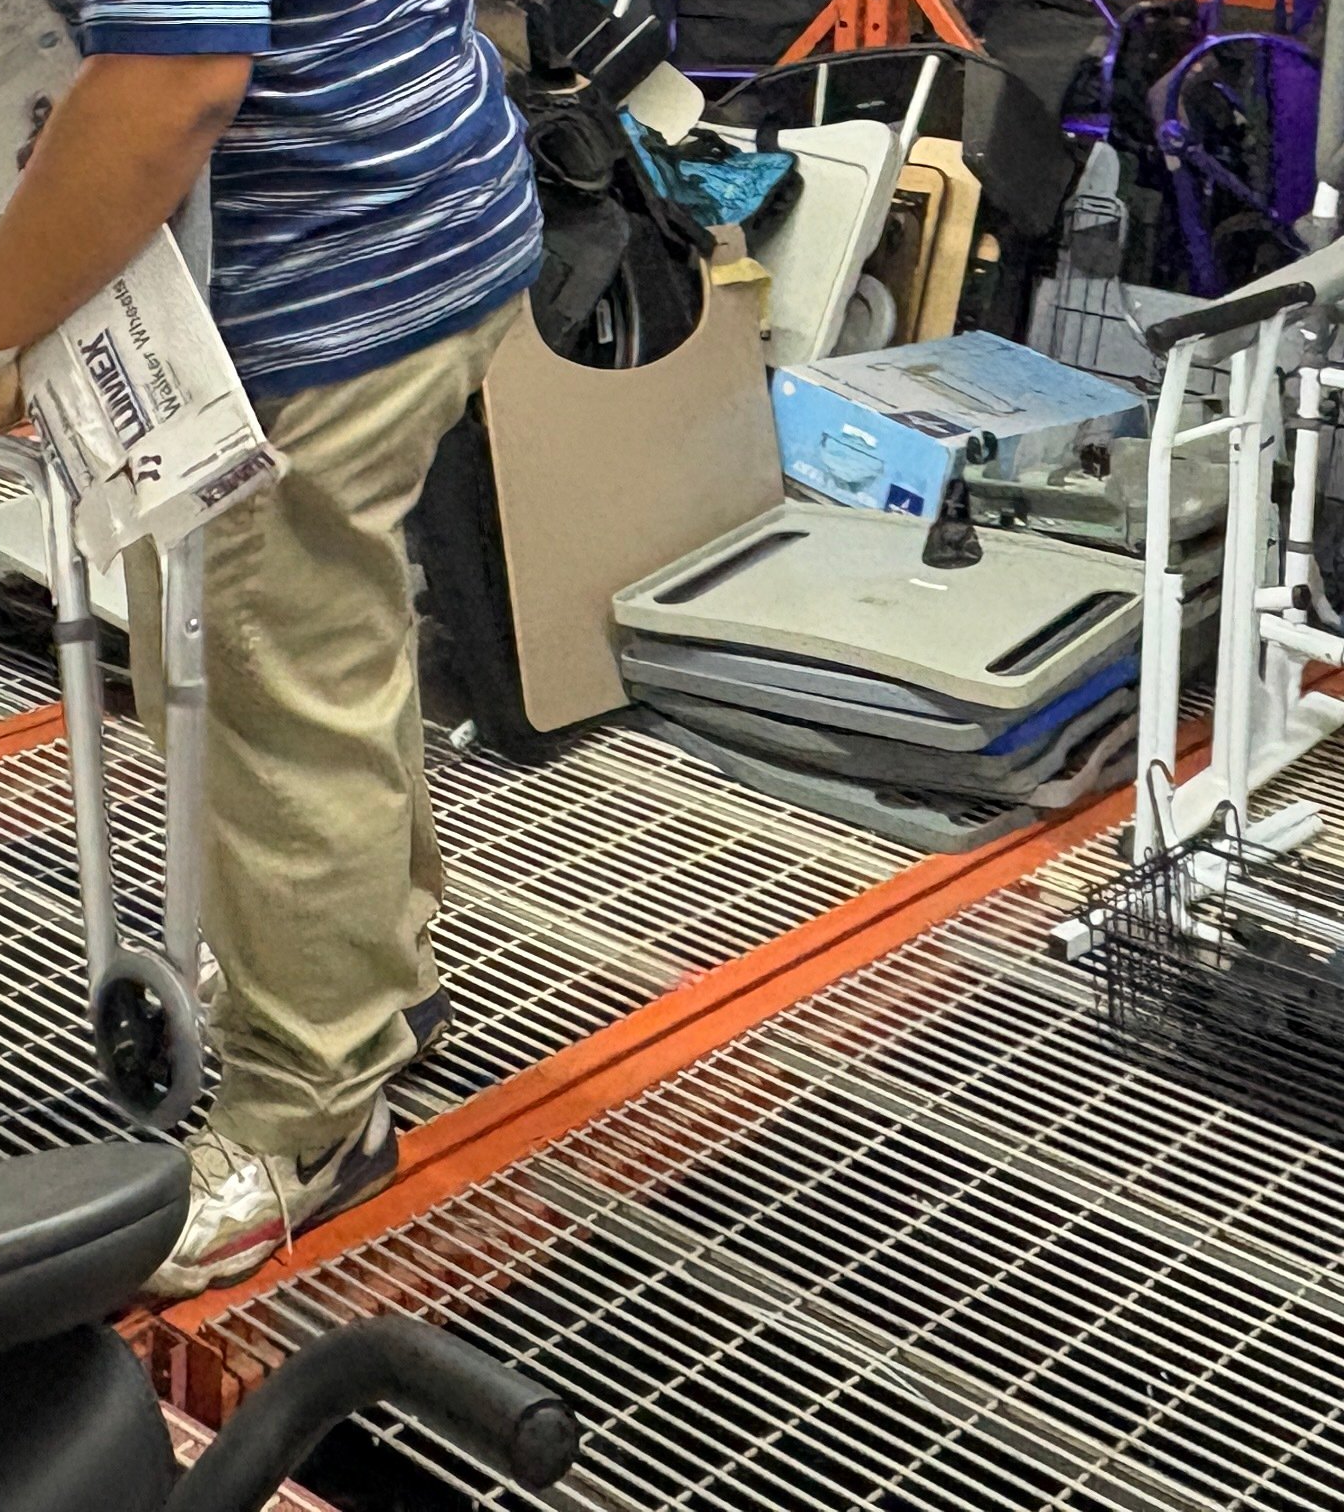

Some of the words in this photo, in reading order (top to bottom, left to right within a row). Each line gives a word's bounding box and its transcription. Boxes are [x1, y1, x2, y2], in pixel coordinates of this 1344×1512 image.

[111, 278, 151, 350] Wheels
[80, 331, 148, 450] LUMEX
[143, 353, 181, 420] Walker
